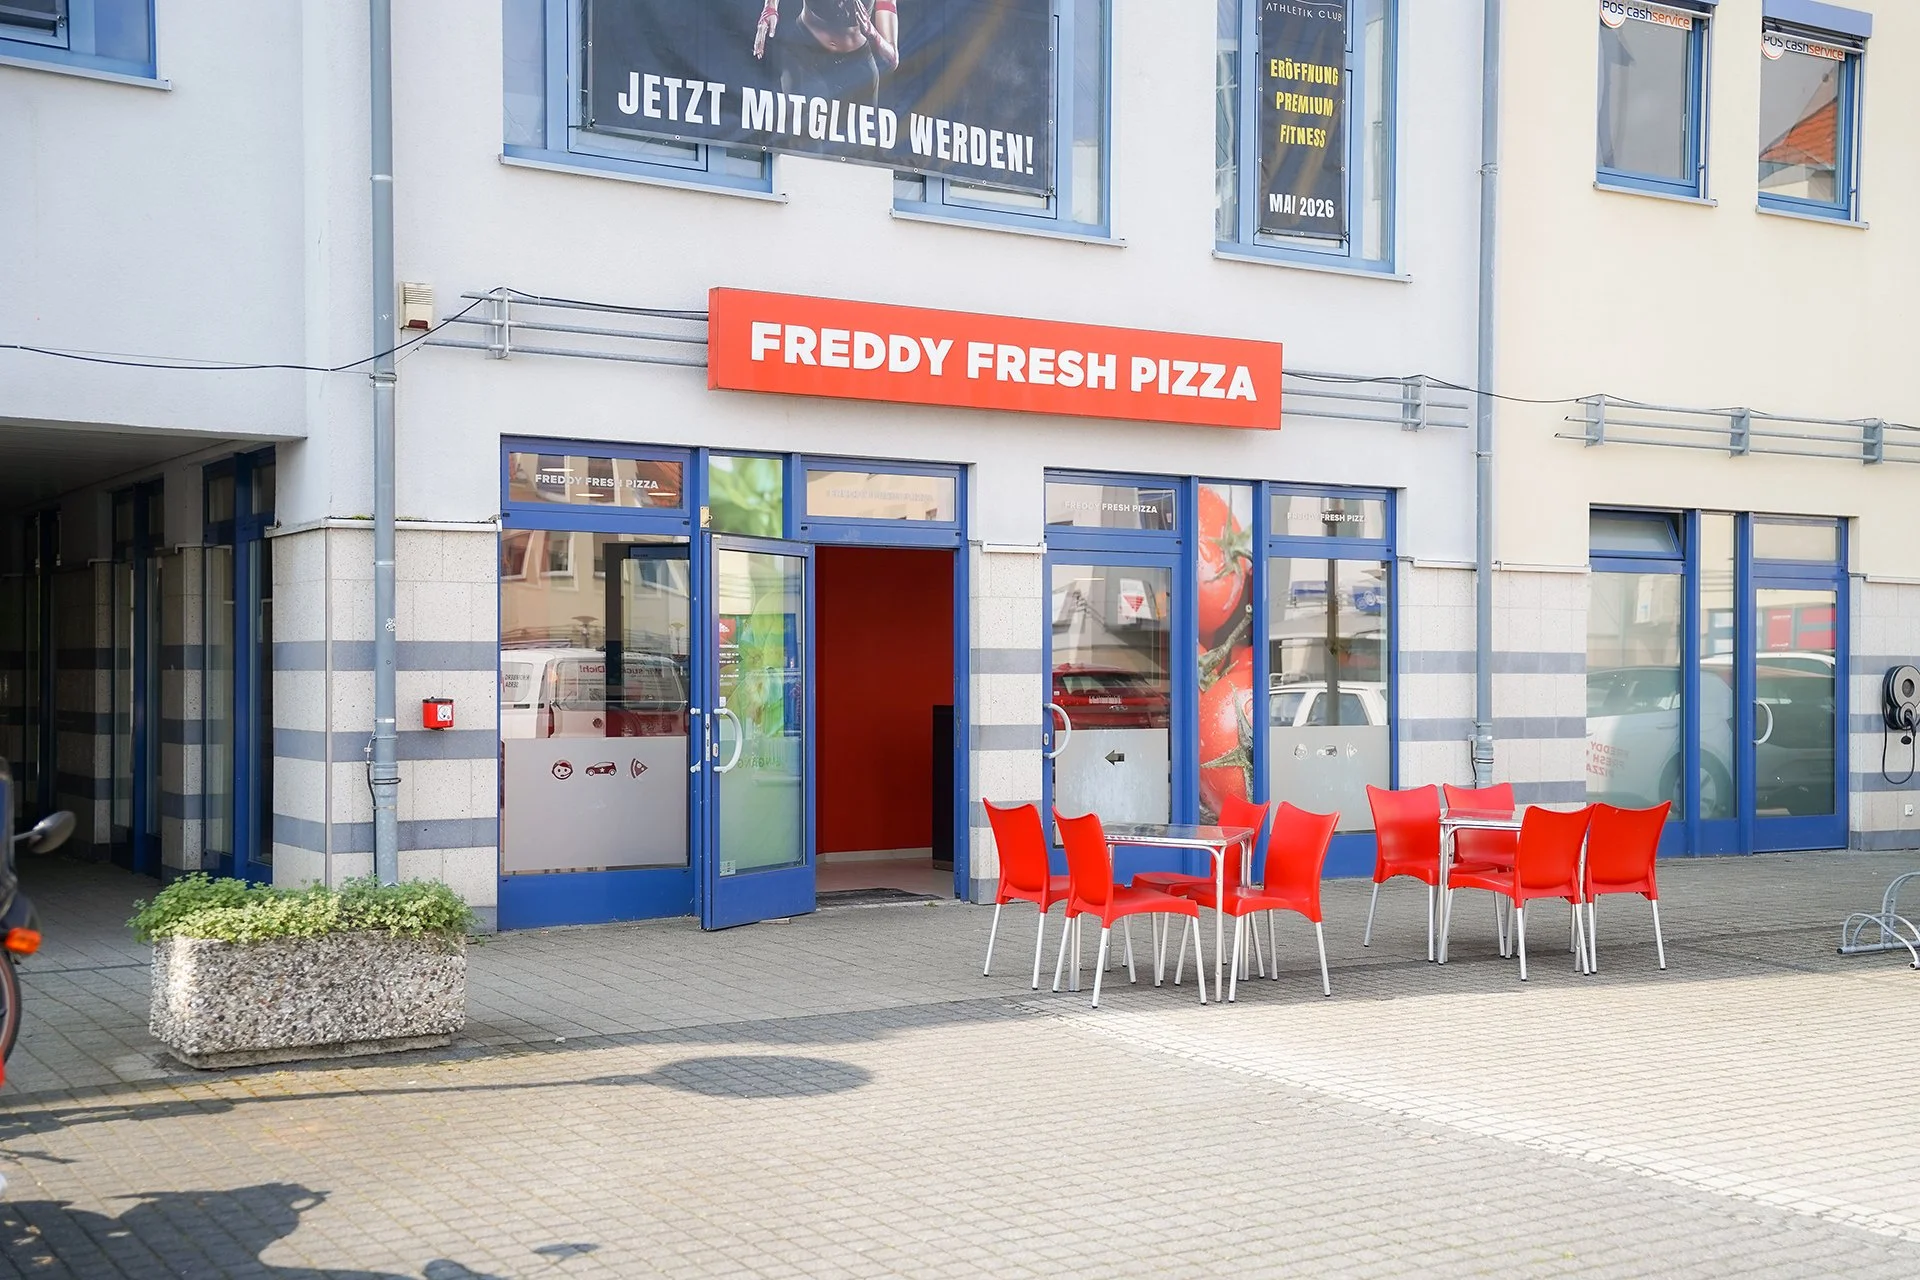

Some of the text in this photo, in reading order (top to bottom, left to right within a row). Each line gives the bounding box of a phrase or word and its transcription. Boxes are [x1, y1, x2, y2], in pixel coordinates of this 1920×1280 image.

[1265, 2, 1343, 22] ATHLETIK CLUB
[1602, 0, 1690, 29] POS cashservice
[1270, 58, 1339, 86] ERÖFFNUNG
[1275, 91, 1334, 117] PREMIUM
[617, 71, 1035, 175] JETZT MITGLIED WERDEN!
[1280, 124, 1327, 148] FITNESS
[1269, 193, 1335, 218] MAI 2026
[750, 320, 1258, 402] FREDDY FRESH PIZZA
[535, 474, 659, 489] FREDDY FRESH PIZZA
[1102, 503, 1131, 512] FRESH
[1132, 505, 1158, 514] PIZZA
[1320, 513, 1346, 522] FRESH
